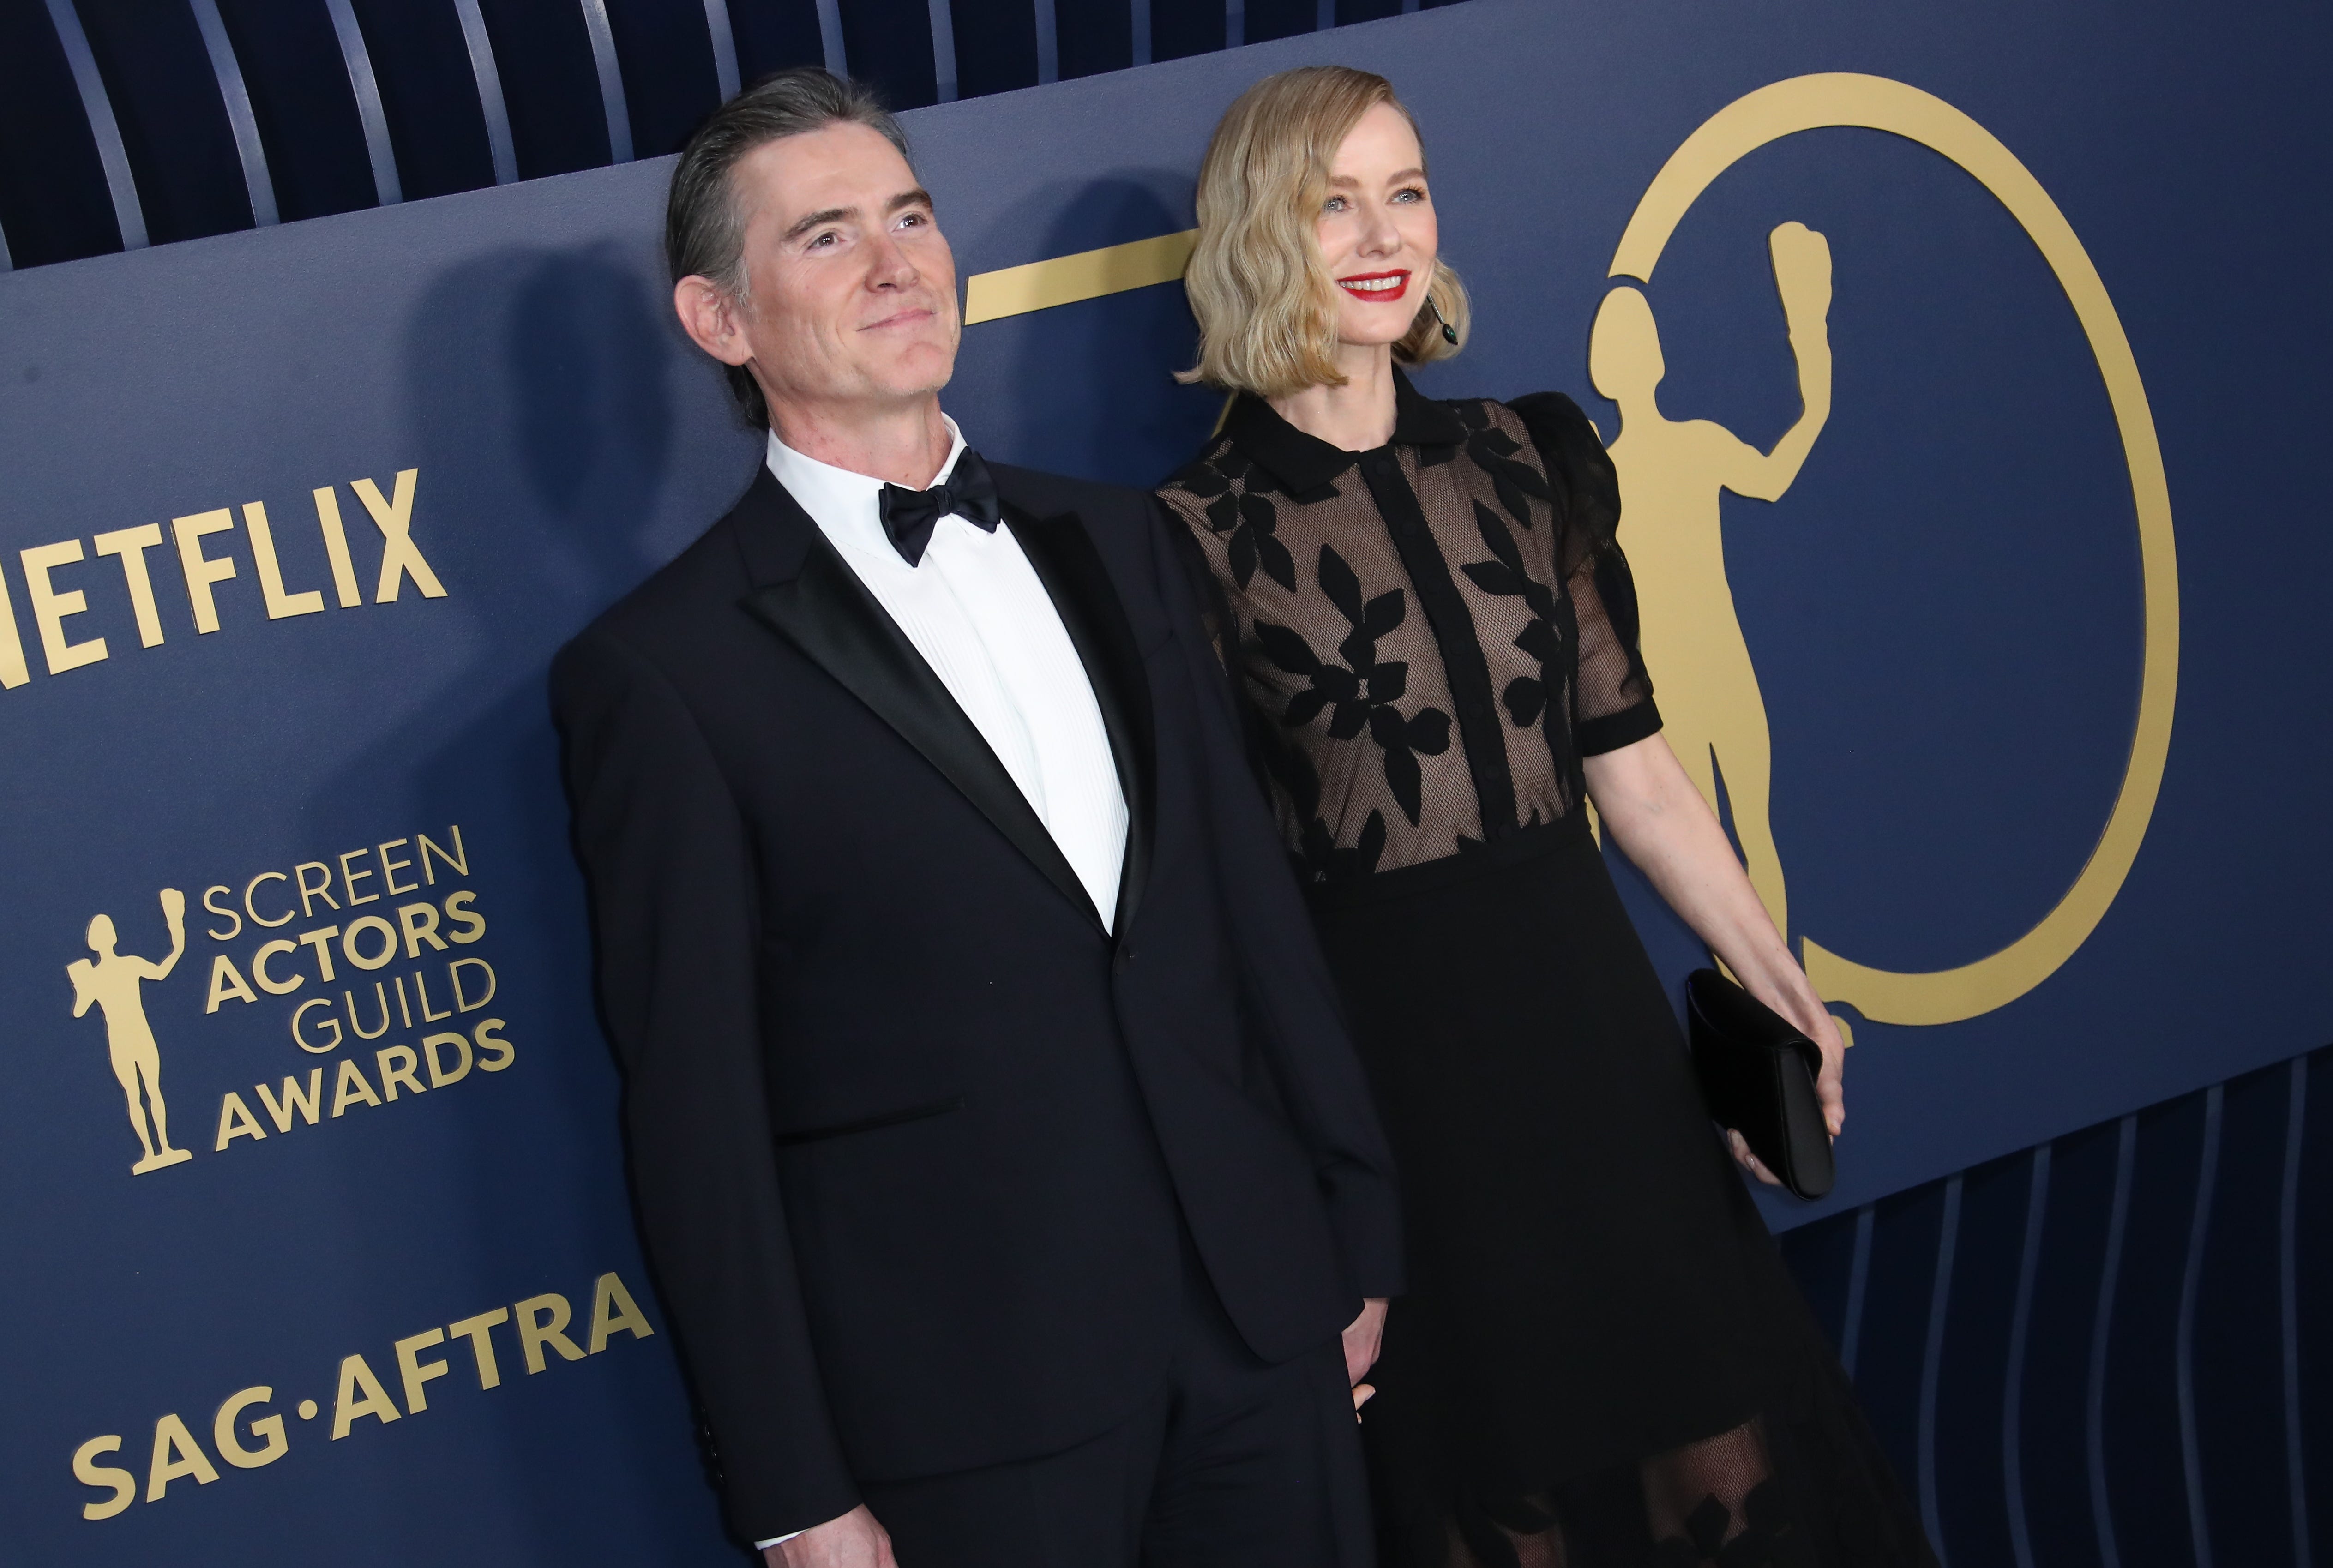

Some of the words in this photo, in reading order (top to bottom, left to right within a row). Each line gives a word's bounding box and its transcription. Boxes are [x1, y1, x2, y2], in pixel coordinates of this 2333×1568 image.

[204, 824, 469, 941] SCREEN
[206, 890, 486, 1014] ACTORS
[292, 958, 496, 1054] GUILD
[215, 1018, 515, 1152] AWARDS
